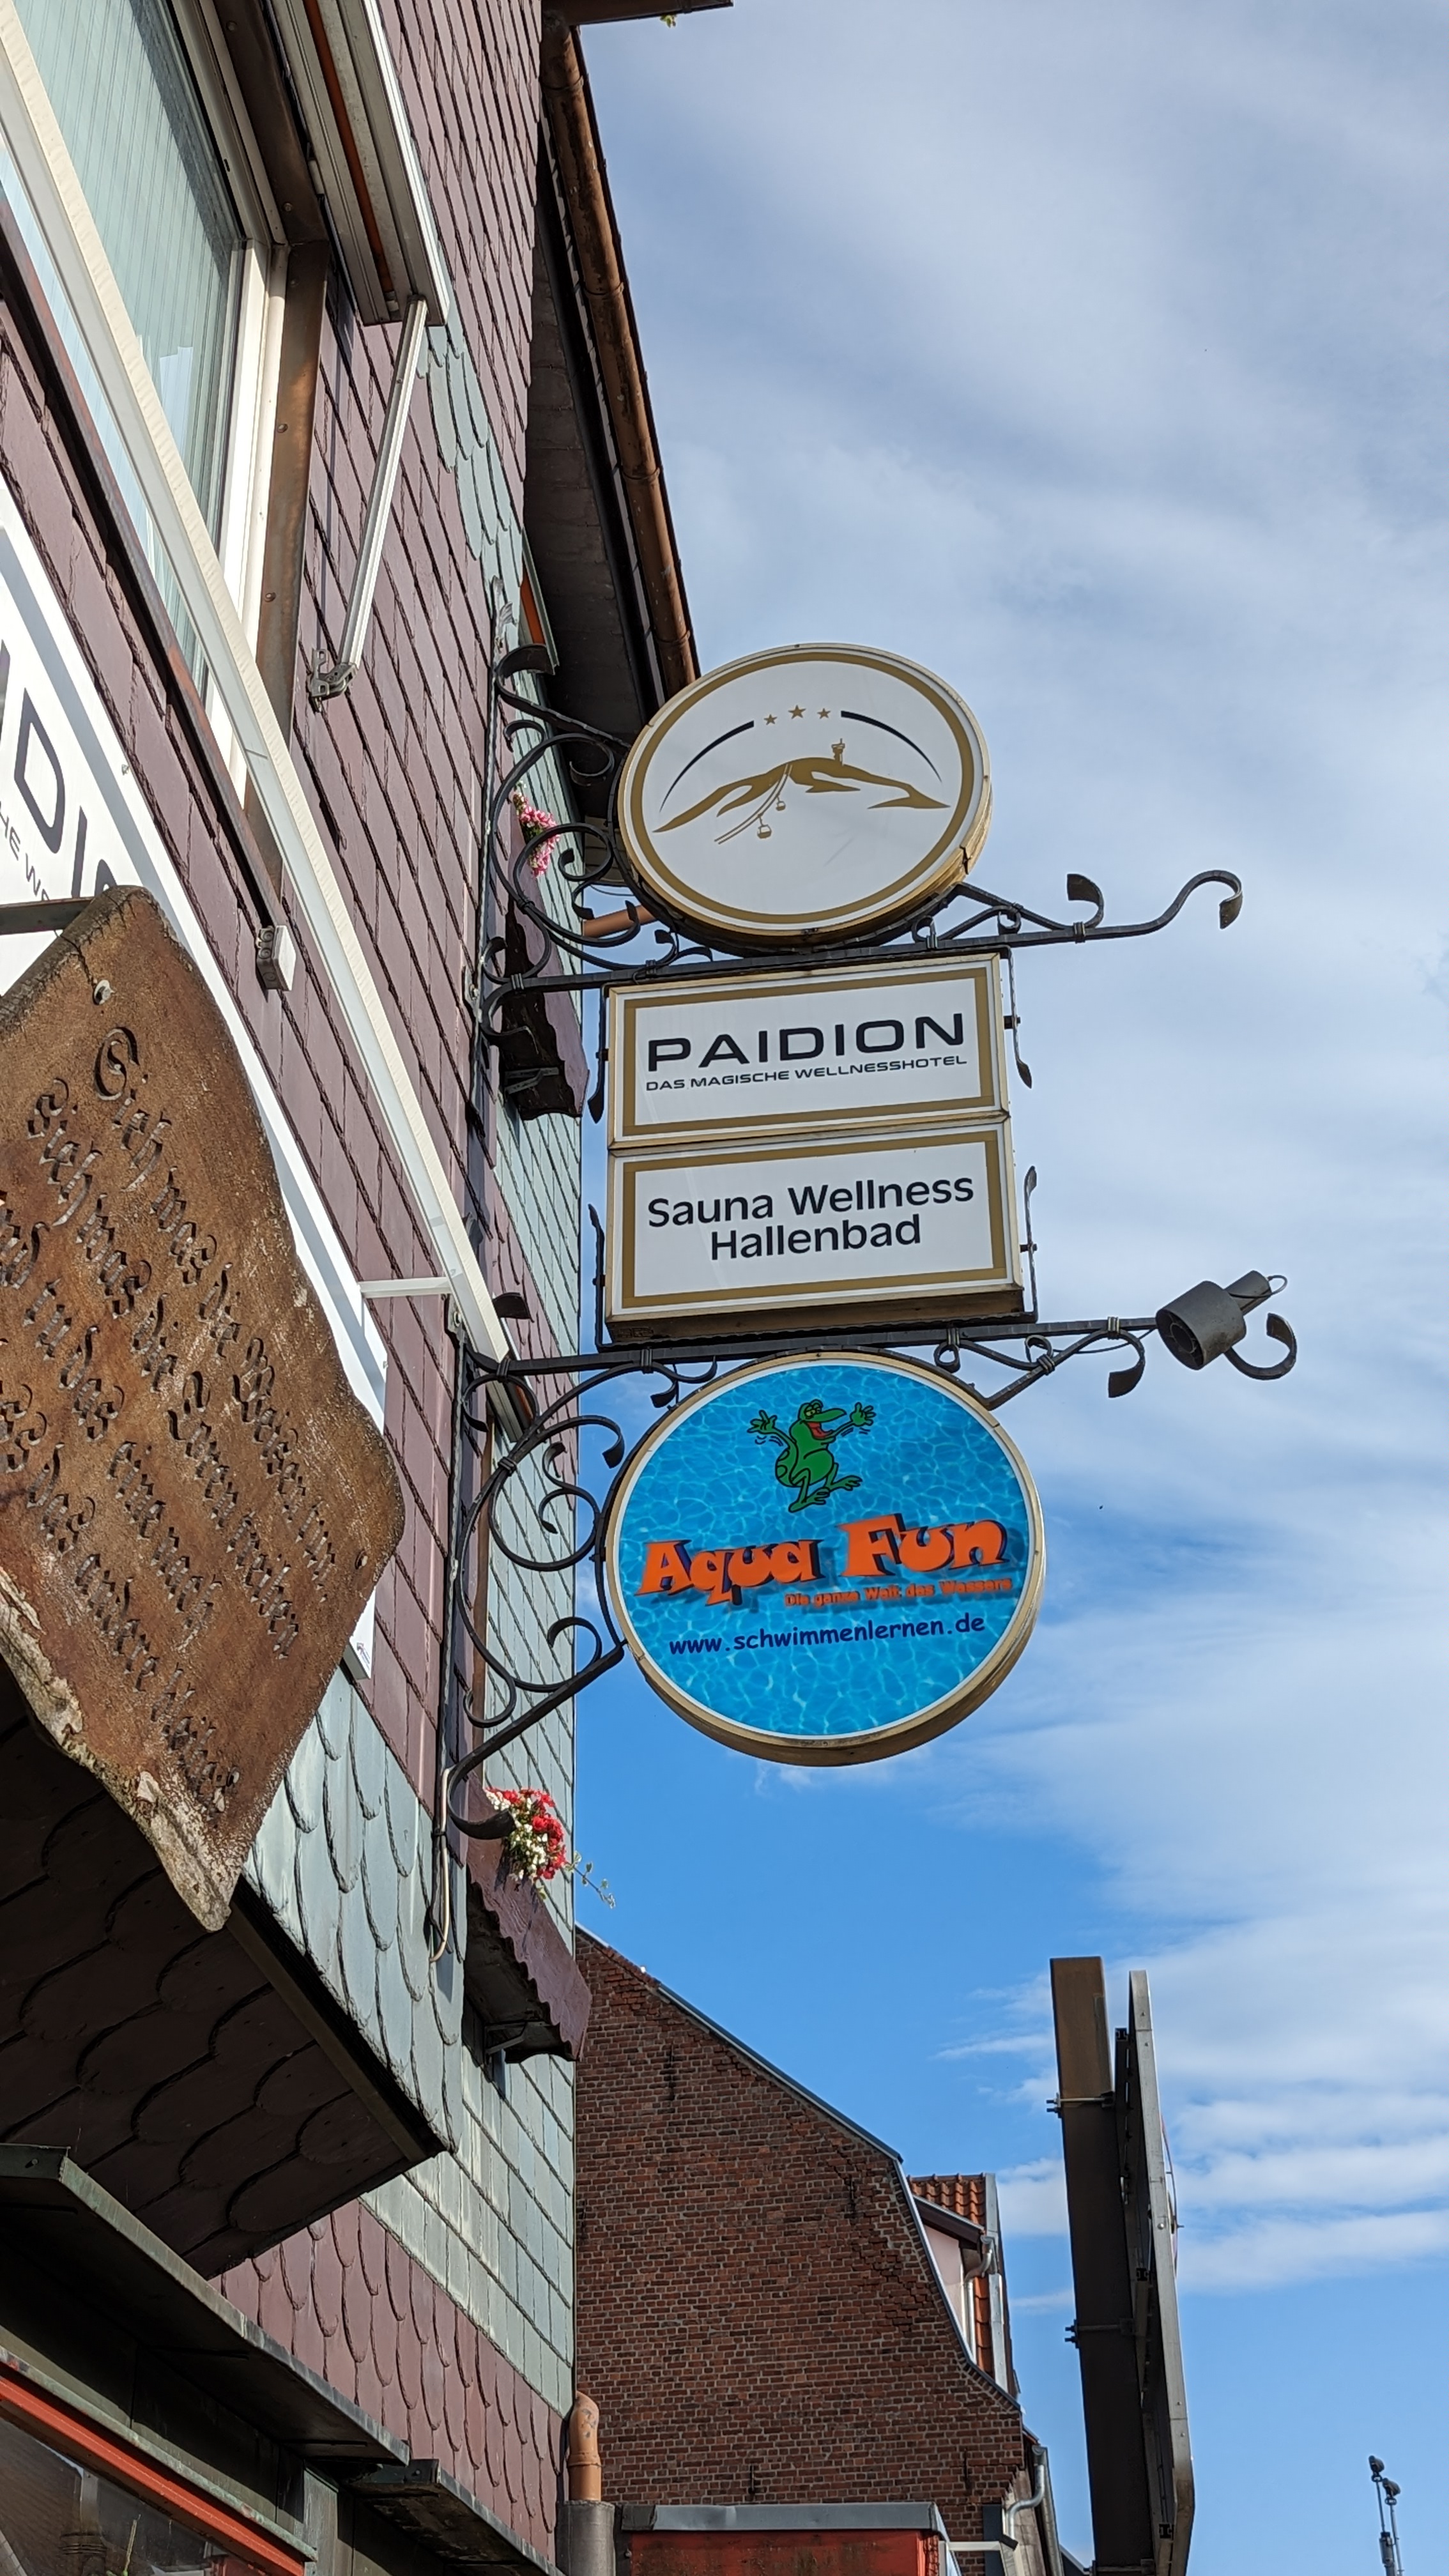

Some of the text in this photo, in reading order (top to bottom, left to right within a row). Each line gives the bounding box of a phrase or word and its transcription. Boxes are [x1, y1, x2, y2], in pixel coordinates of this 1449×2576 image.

[648, 1013, 964, 1071] PAIDION
[646, 1055, 968, 1091] DAS MAGISCHE WELLNESSHOTEL
[648, 1177, 974, 1227] Sauna Wellness
[150, 1165, 215, 1285] was
[198, 1261, 241, 1357] die
[710, 1214, 921, 1260] Hallenbad
[77, 1194, 151, 1317] was
[131, 1292, 178, 1393] die
[226, 1510, 299, 1660] treiben
[26, 1443, 95, 1556] das
[59, 1325, 124, 1443] das
[107, 1443, 165, 1540] eine
[150, 1527, 222, 1650] nach
[636, 1513, 1009, 1606] Aqua Fun
[785, 1593, 809, 1606] Die
[814, 1591, 860, 1607] ganze
[939, 1578, 1013, 1595] Wassers
[669, 1612, 985, 1654] www.schwimmenlernen.de
